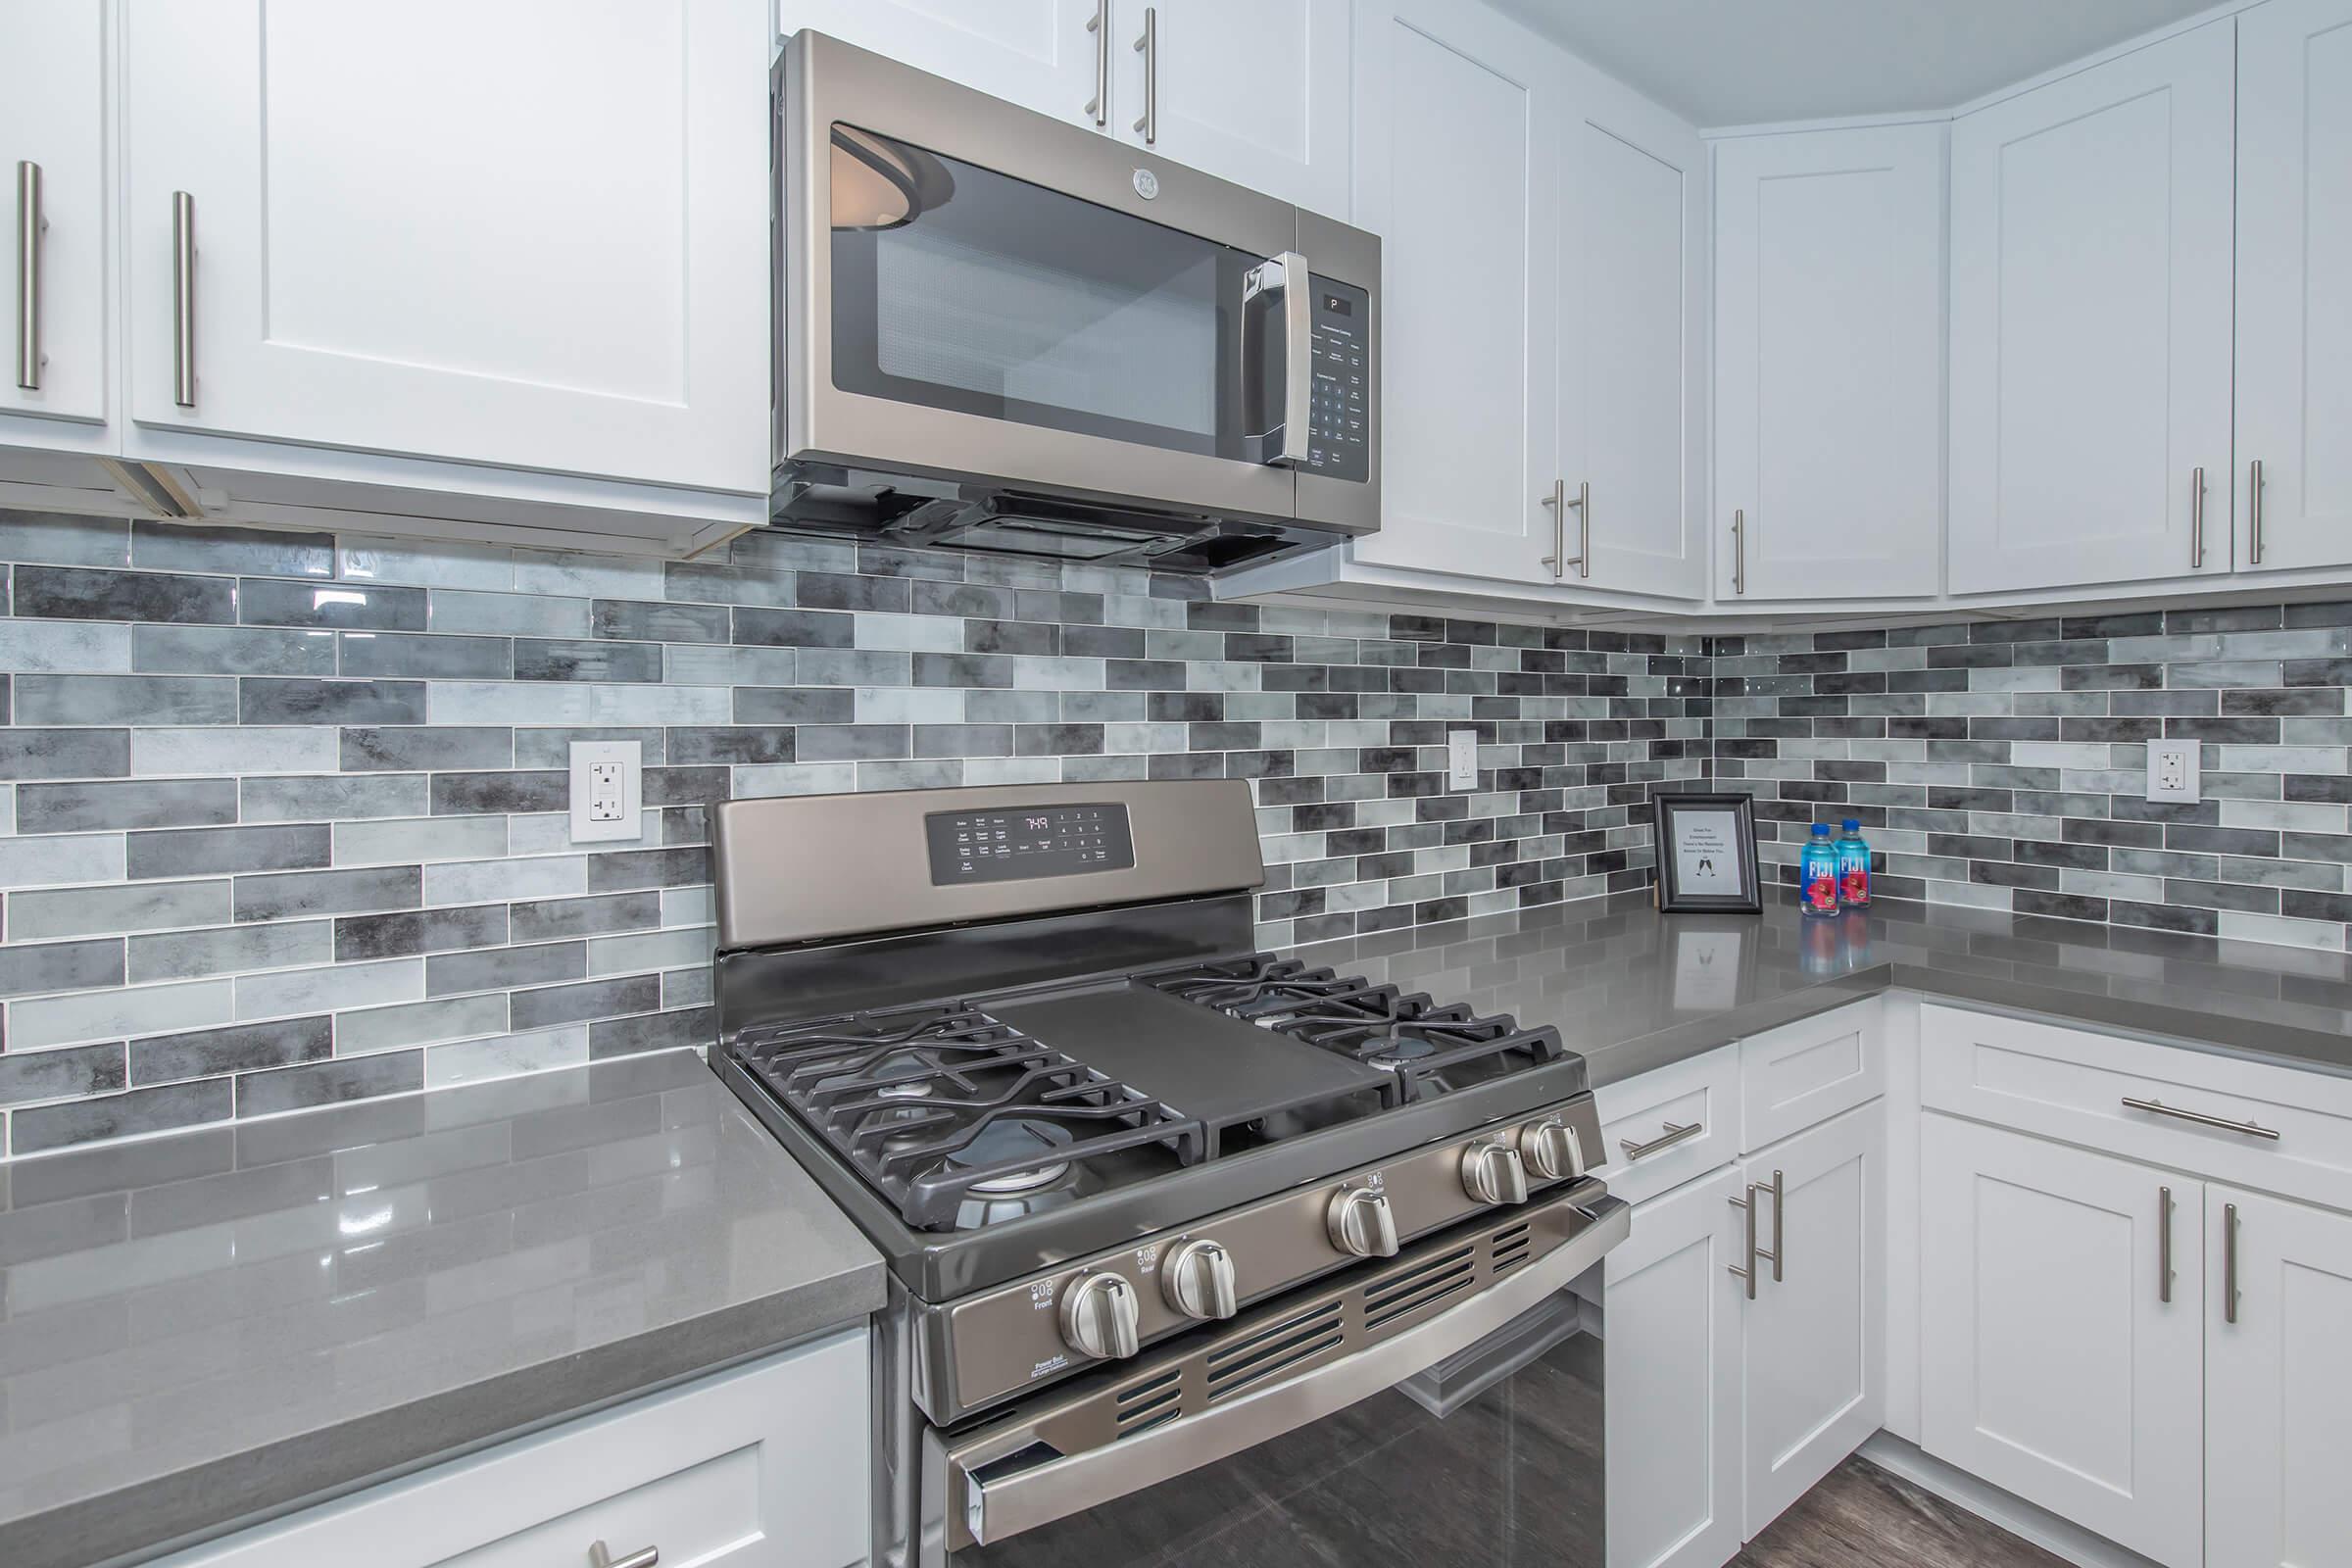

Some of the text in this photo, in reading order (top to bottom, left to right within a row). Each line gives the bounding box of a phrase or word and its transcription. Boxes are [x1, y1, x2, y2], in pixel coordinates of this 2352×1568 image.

[1809, 861, 1834, 877] FIJI
[1840, 857, 1864, 872] FIJI
[1034, 1298, 1053, 1310] Front
